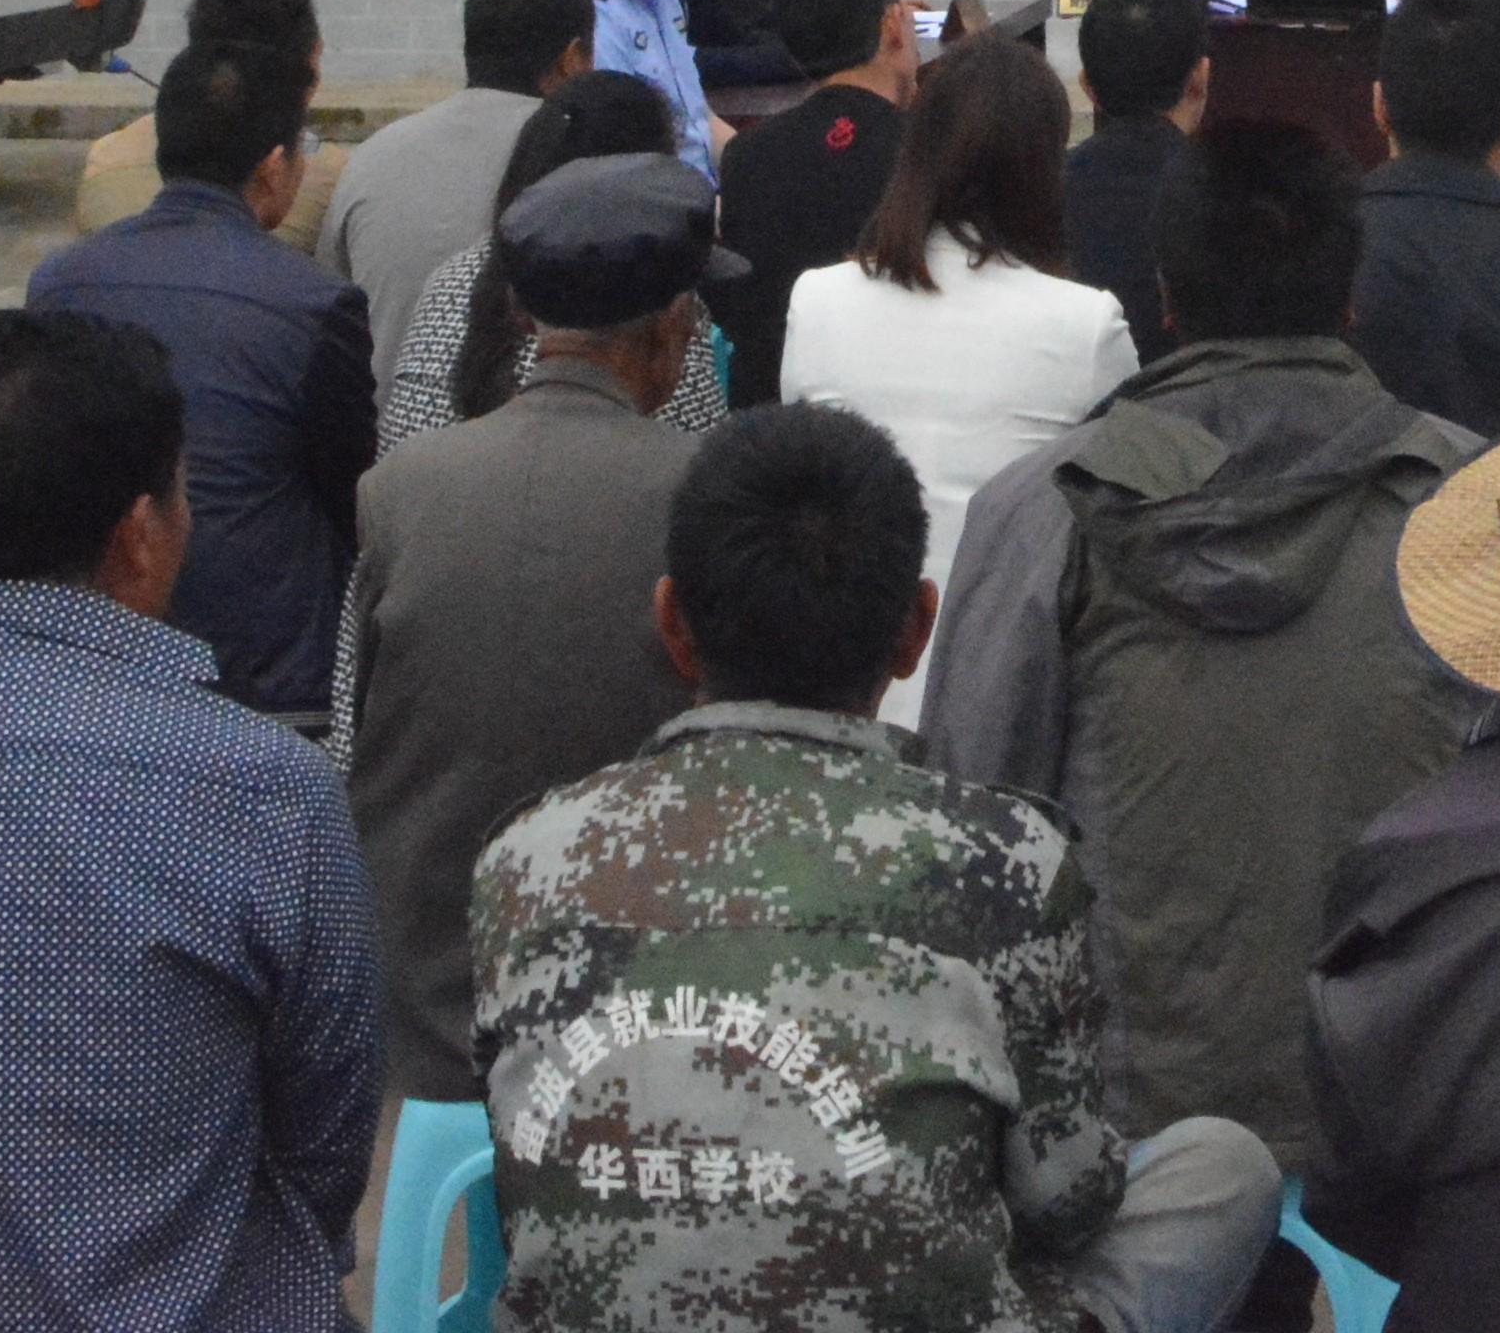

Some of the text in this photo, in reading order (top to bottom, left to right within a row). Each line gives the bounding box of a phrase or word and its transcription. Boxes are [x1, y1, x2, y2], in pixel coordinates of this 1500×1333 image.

[510, 985, 892, 1181] 雷波县就业技能培训
[577, 1144, 798, 1206] 华西学校
